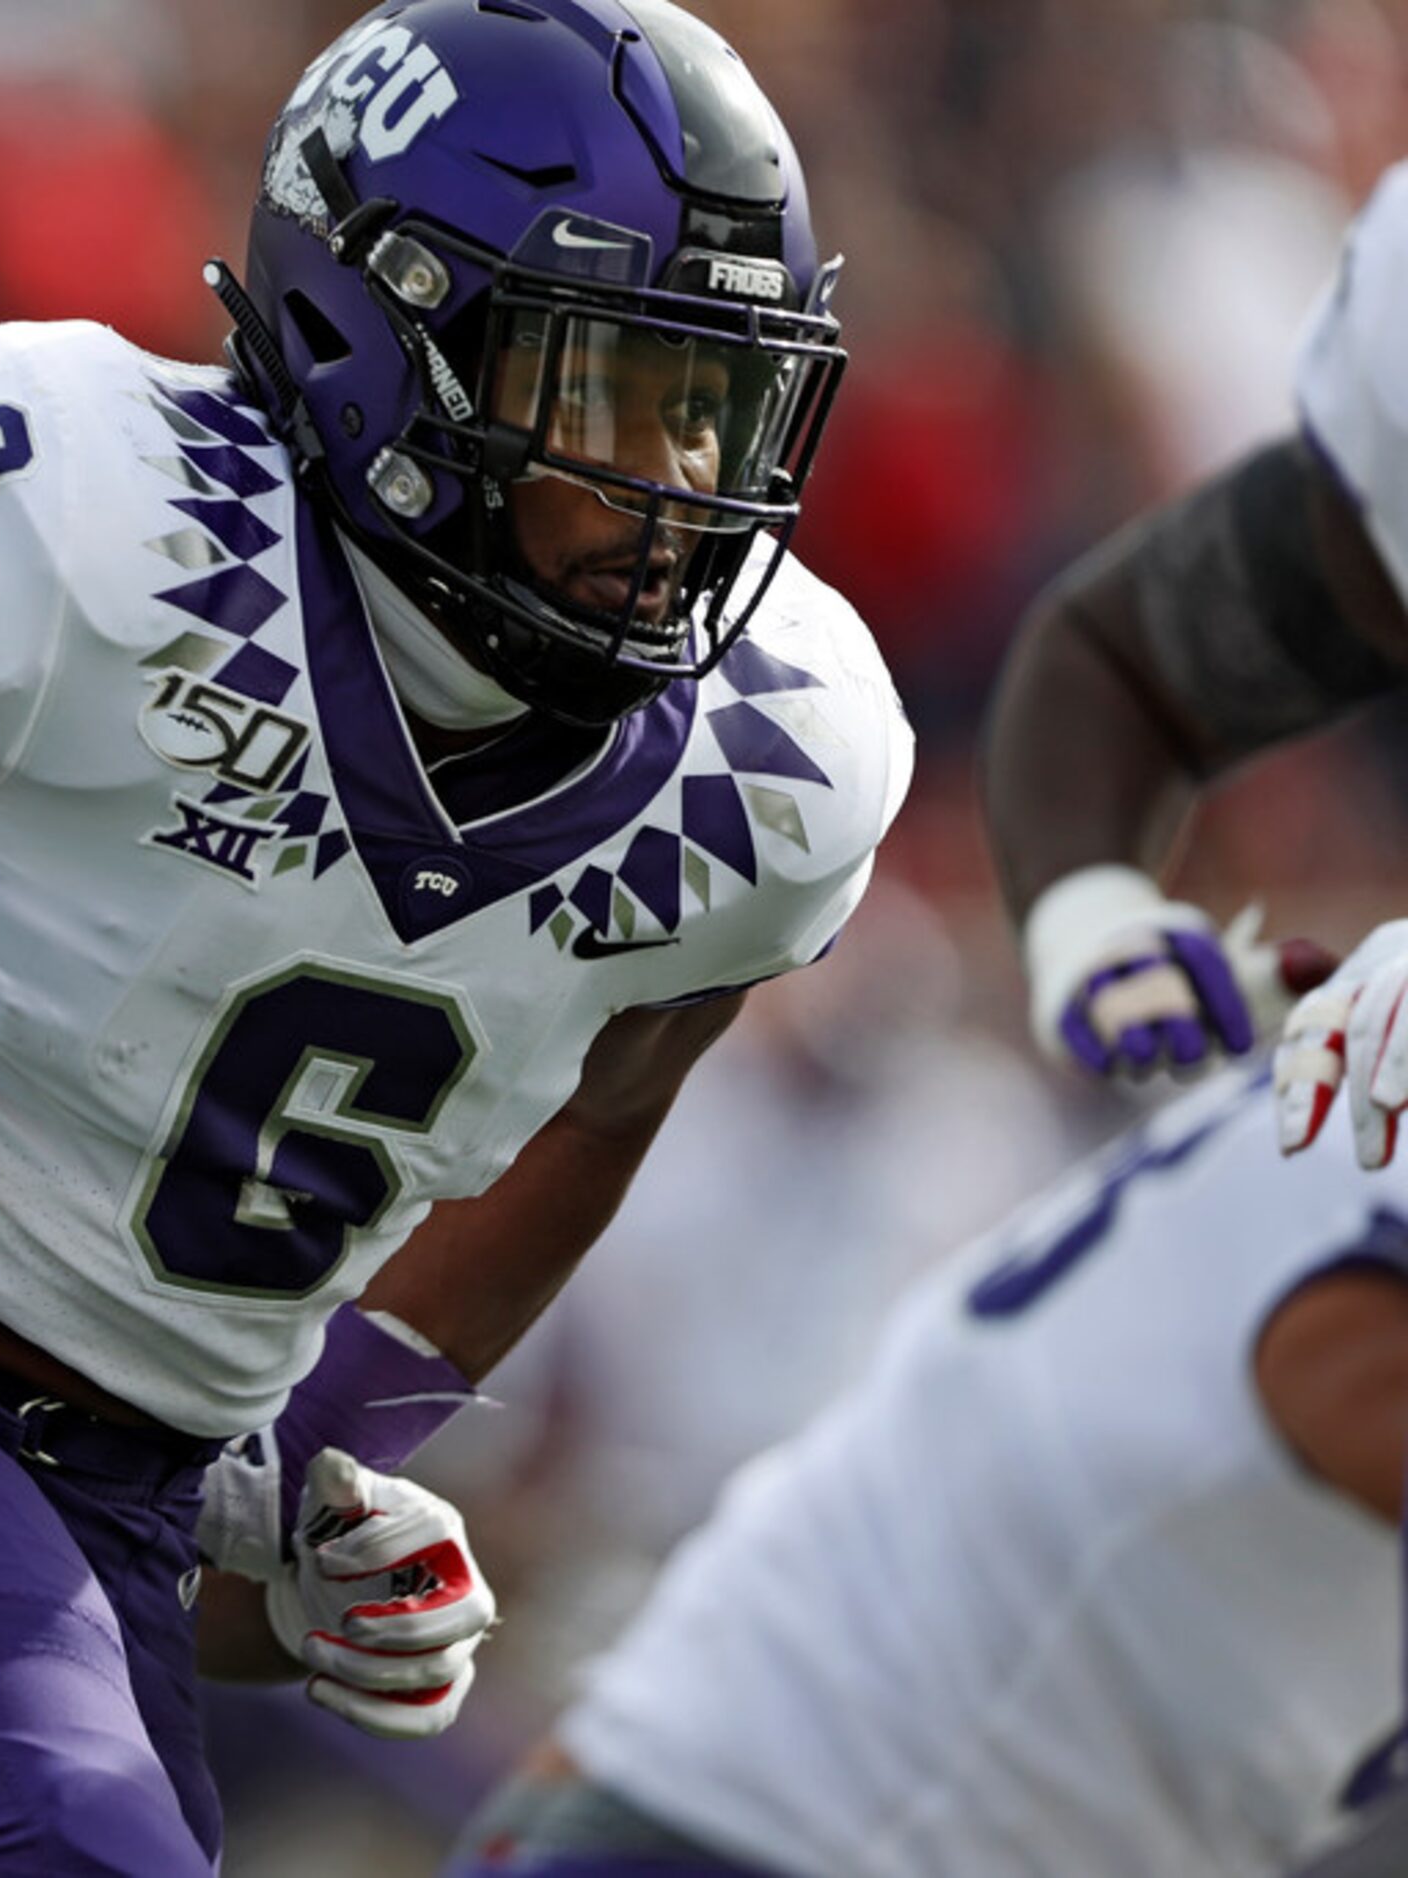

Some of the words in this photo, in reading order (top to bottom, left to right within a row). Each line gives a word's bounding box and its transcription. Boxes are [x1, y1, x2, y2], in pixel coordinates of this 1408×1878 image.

[707, 259, 784, 301] FROGS
[146, 672, 311, 792] 150
[413, 869, 460, 898] TCU
[130, 962, 479, 1301] 6
